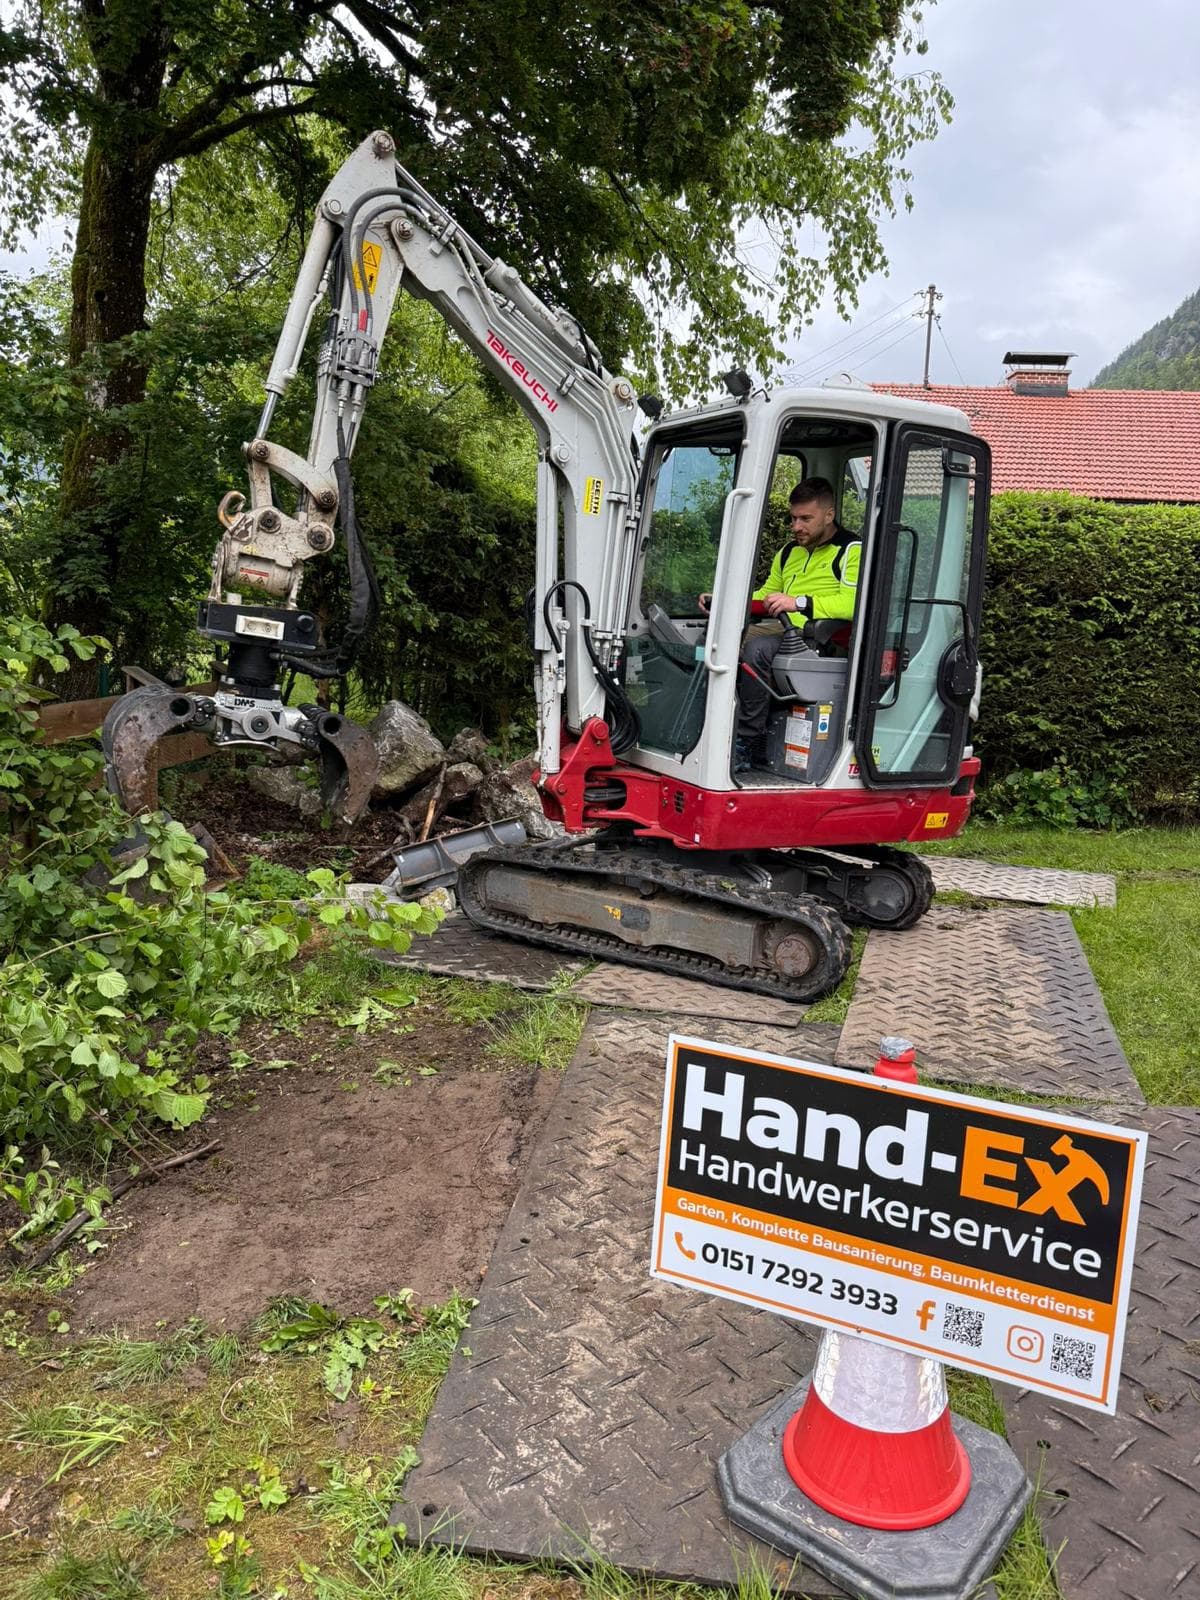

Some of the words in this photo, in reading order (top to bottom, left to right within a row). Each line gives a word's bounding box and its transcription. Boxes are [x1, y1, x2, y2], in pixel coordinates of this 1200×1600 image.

[234, 698, 256, 708] DMS
[683, 1063, 1110, 1226] Hand-Ex
[677, 1197, 729, 1224] Garten,
[731, 1211, 809, 1244] Komplette
[812, 1233, 926, 1278] Bausanierung,
[930, 1265, 1096, 1322] Baumkletterdienst
[679, 1139, 1102, 1279] Handwerkerservice
[702, 1243, 755, 1275] 0151
[761, 1258, 824, 1295] 7292
[830, 1278, 899, 1316] 3933
